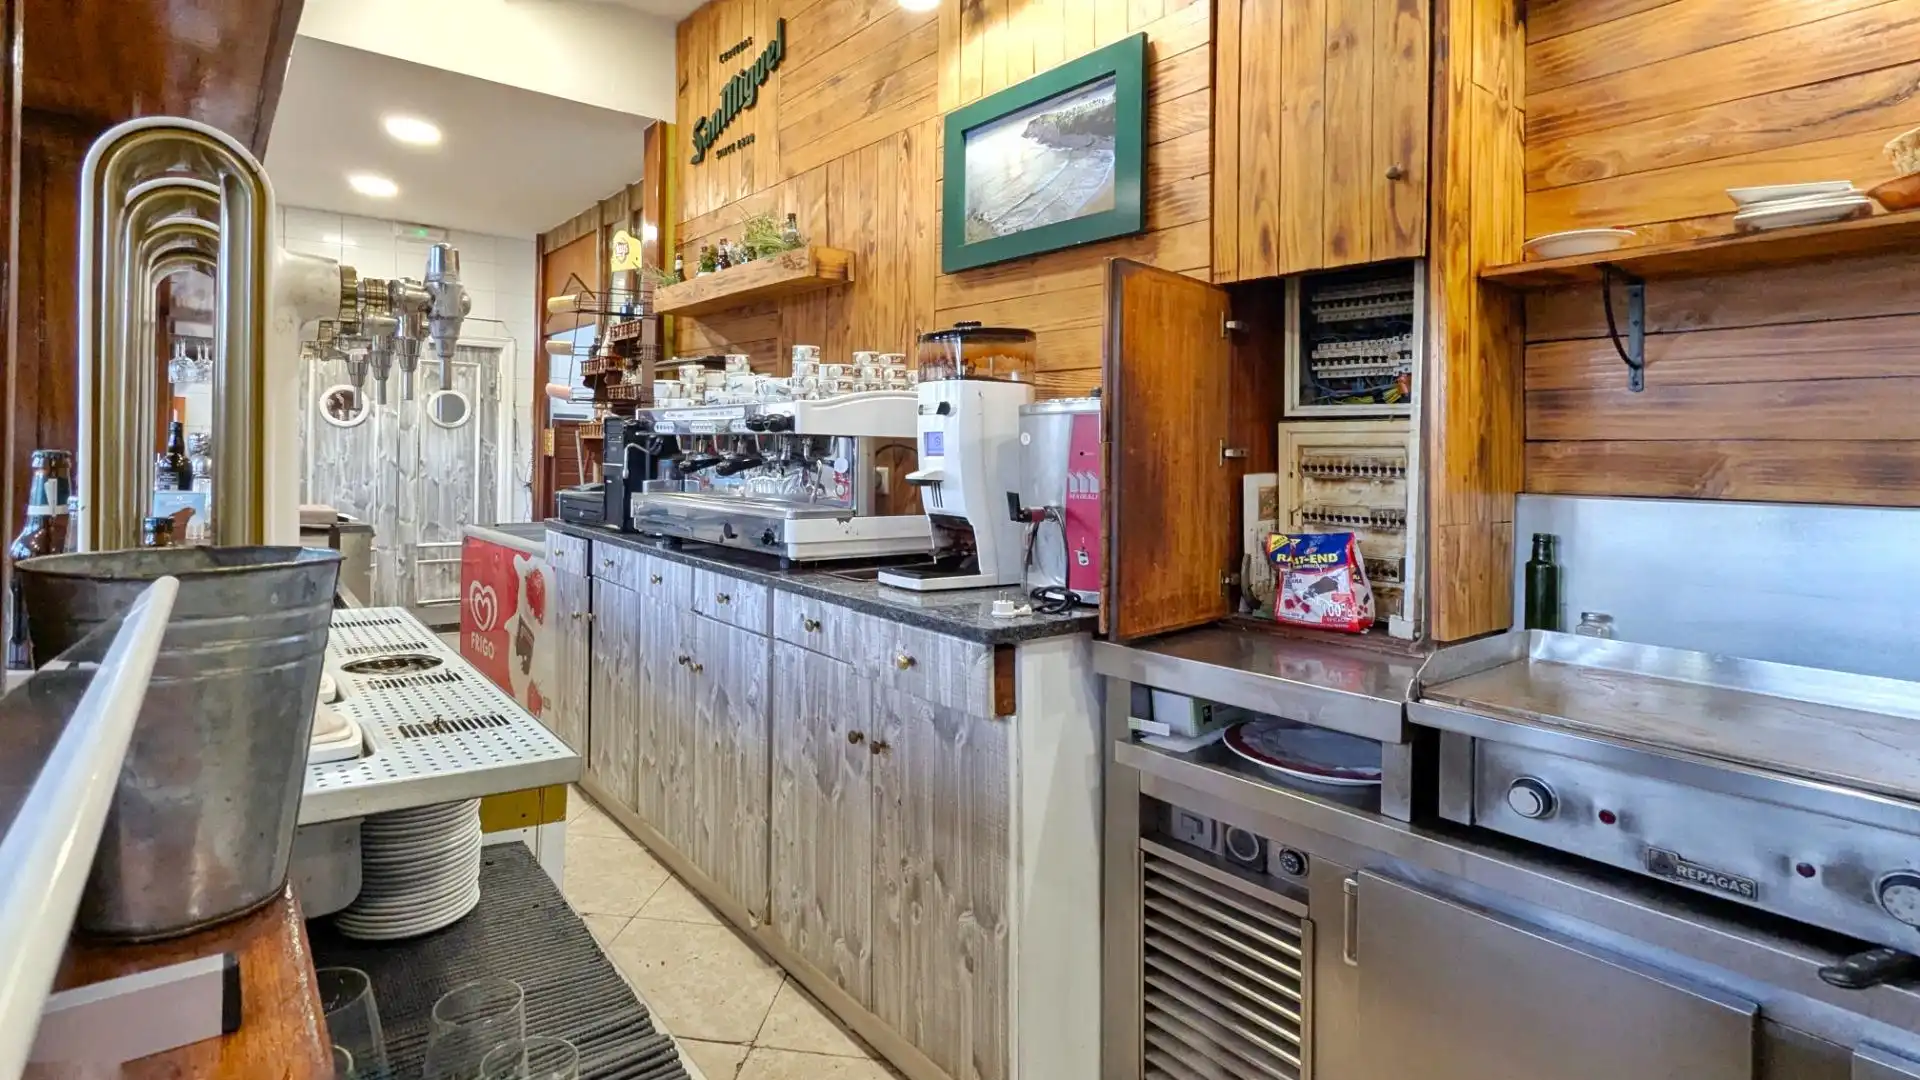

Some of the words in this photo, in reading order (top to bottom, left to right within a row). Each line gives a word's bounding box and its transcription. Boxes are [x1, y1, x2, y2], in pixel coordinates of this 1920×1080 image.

[690, 108, 725, 165] San
[719, 17, 787, 128] Miguel
[470, 632, 495, 660] FRIGO
[1675, 865, 1752, 897] REPAGAS
